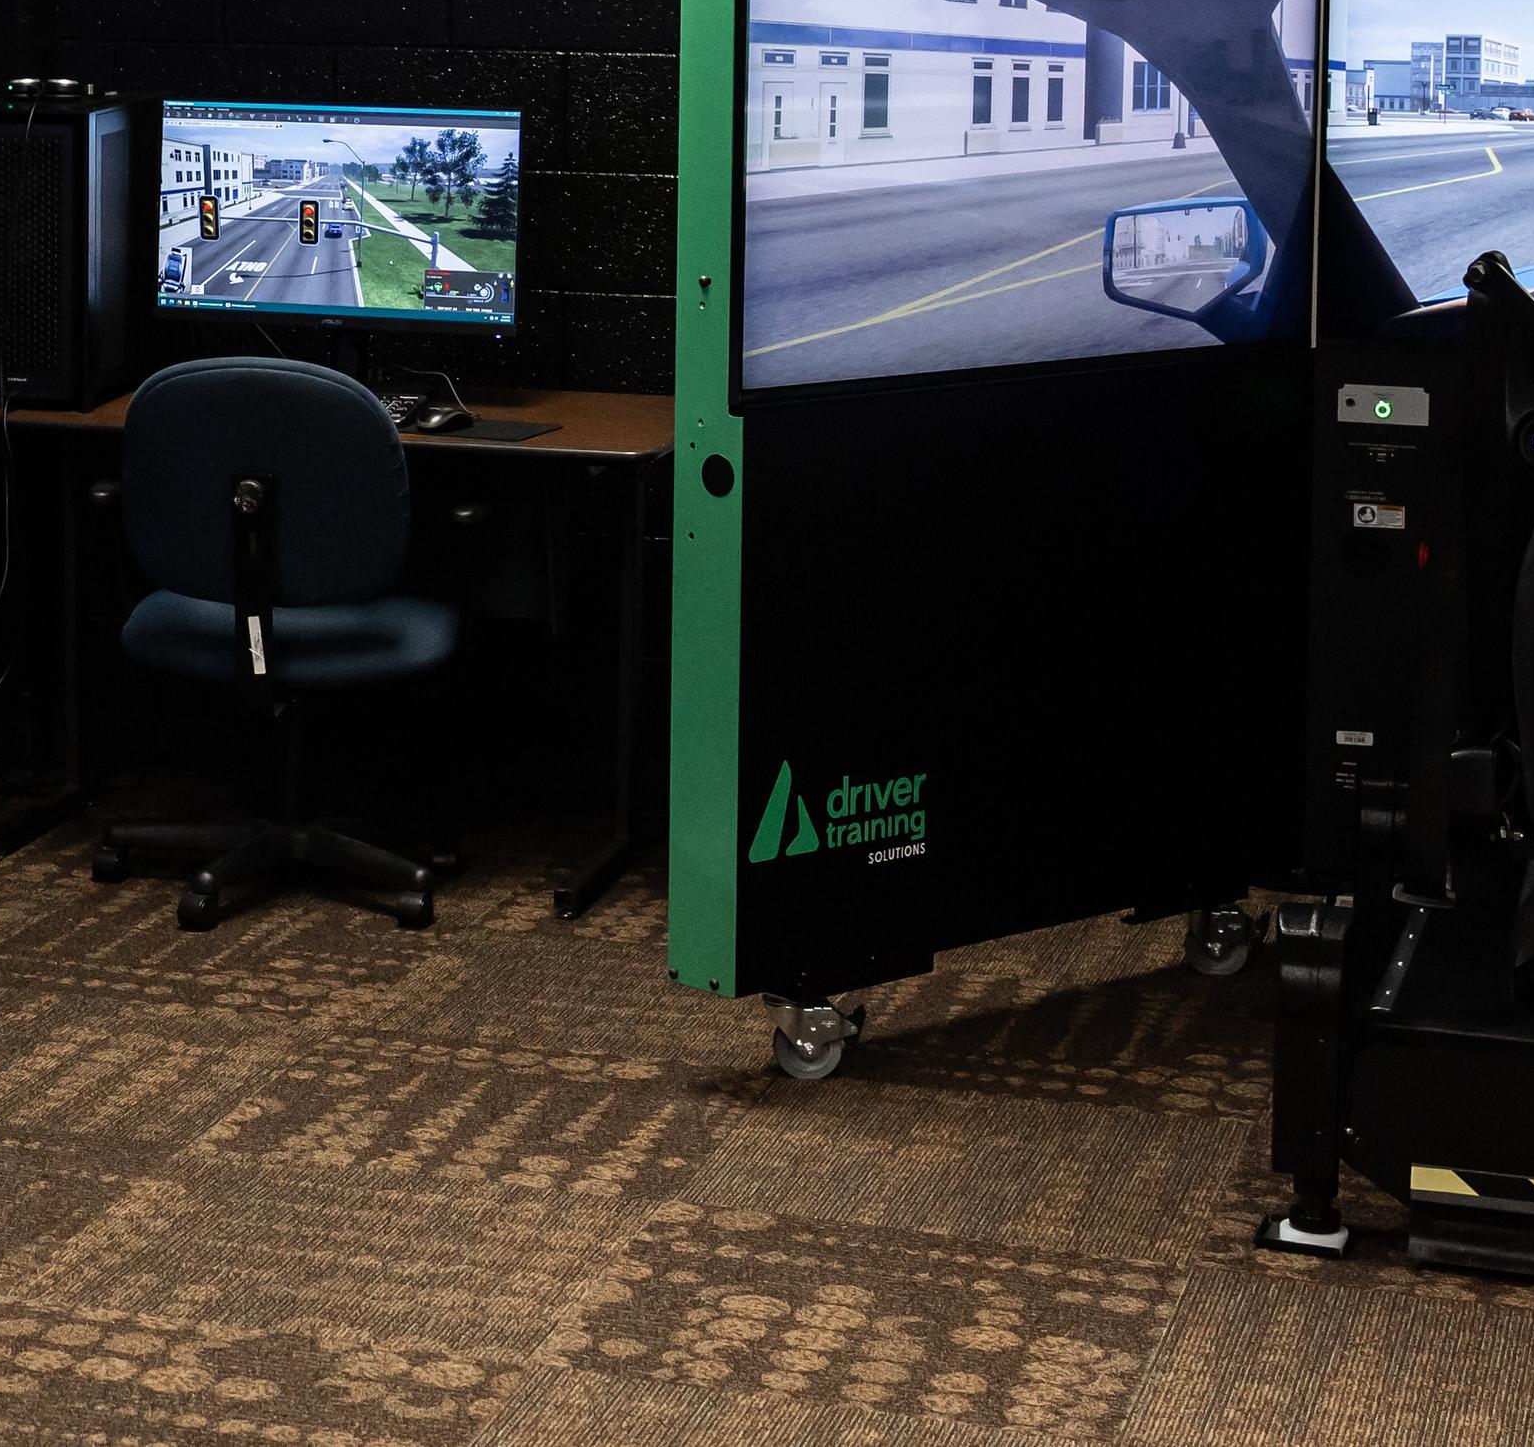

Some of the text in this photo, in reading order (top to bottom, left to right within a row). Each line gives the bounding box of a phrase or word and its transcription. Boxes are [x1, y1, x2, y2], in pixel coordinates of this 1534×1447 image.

[826, 773, 927, 819] driver
[826, 810, 926, 848] training
[868, 842, 926, 865] SOLUTIONS
